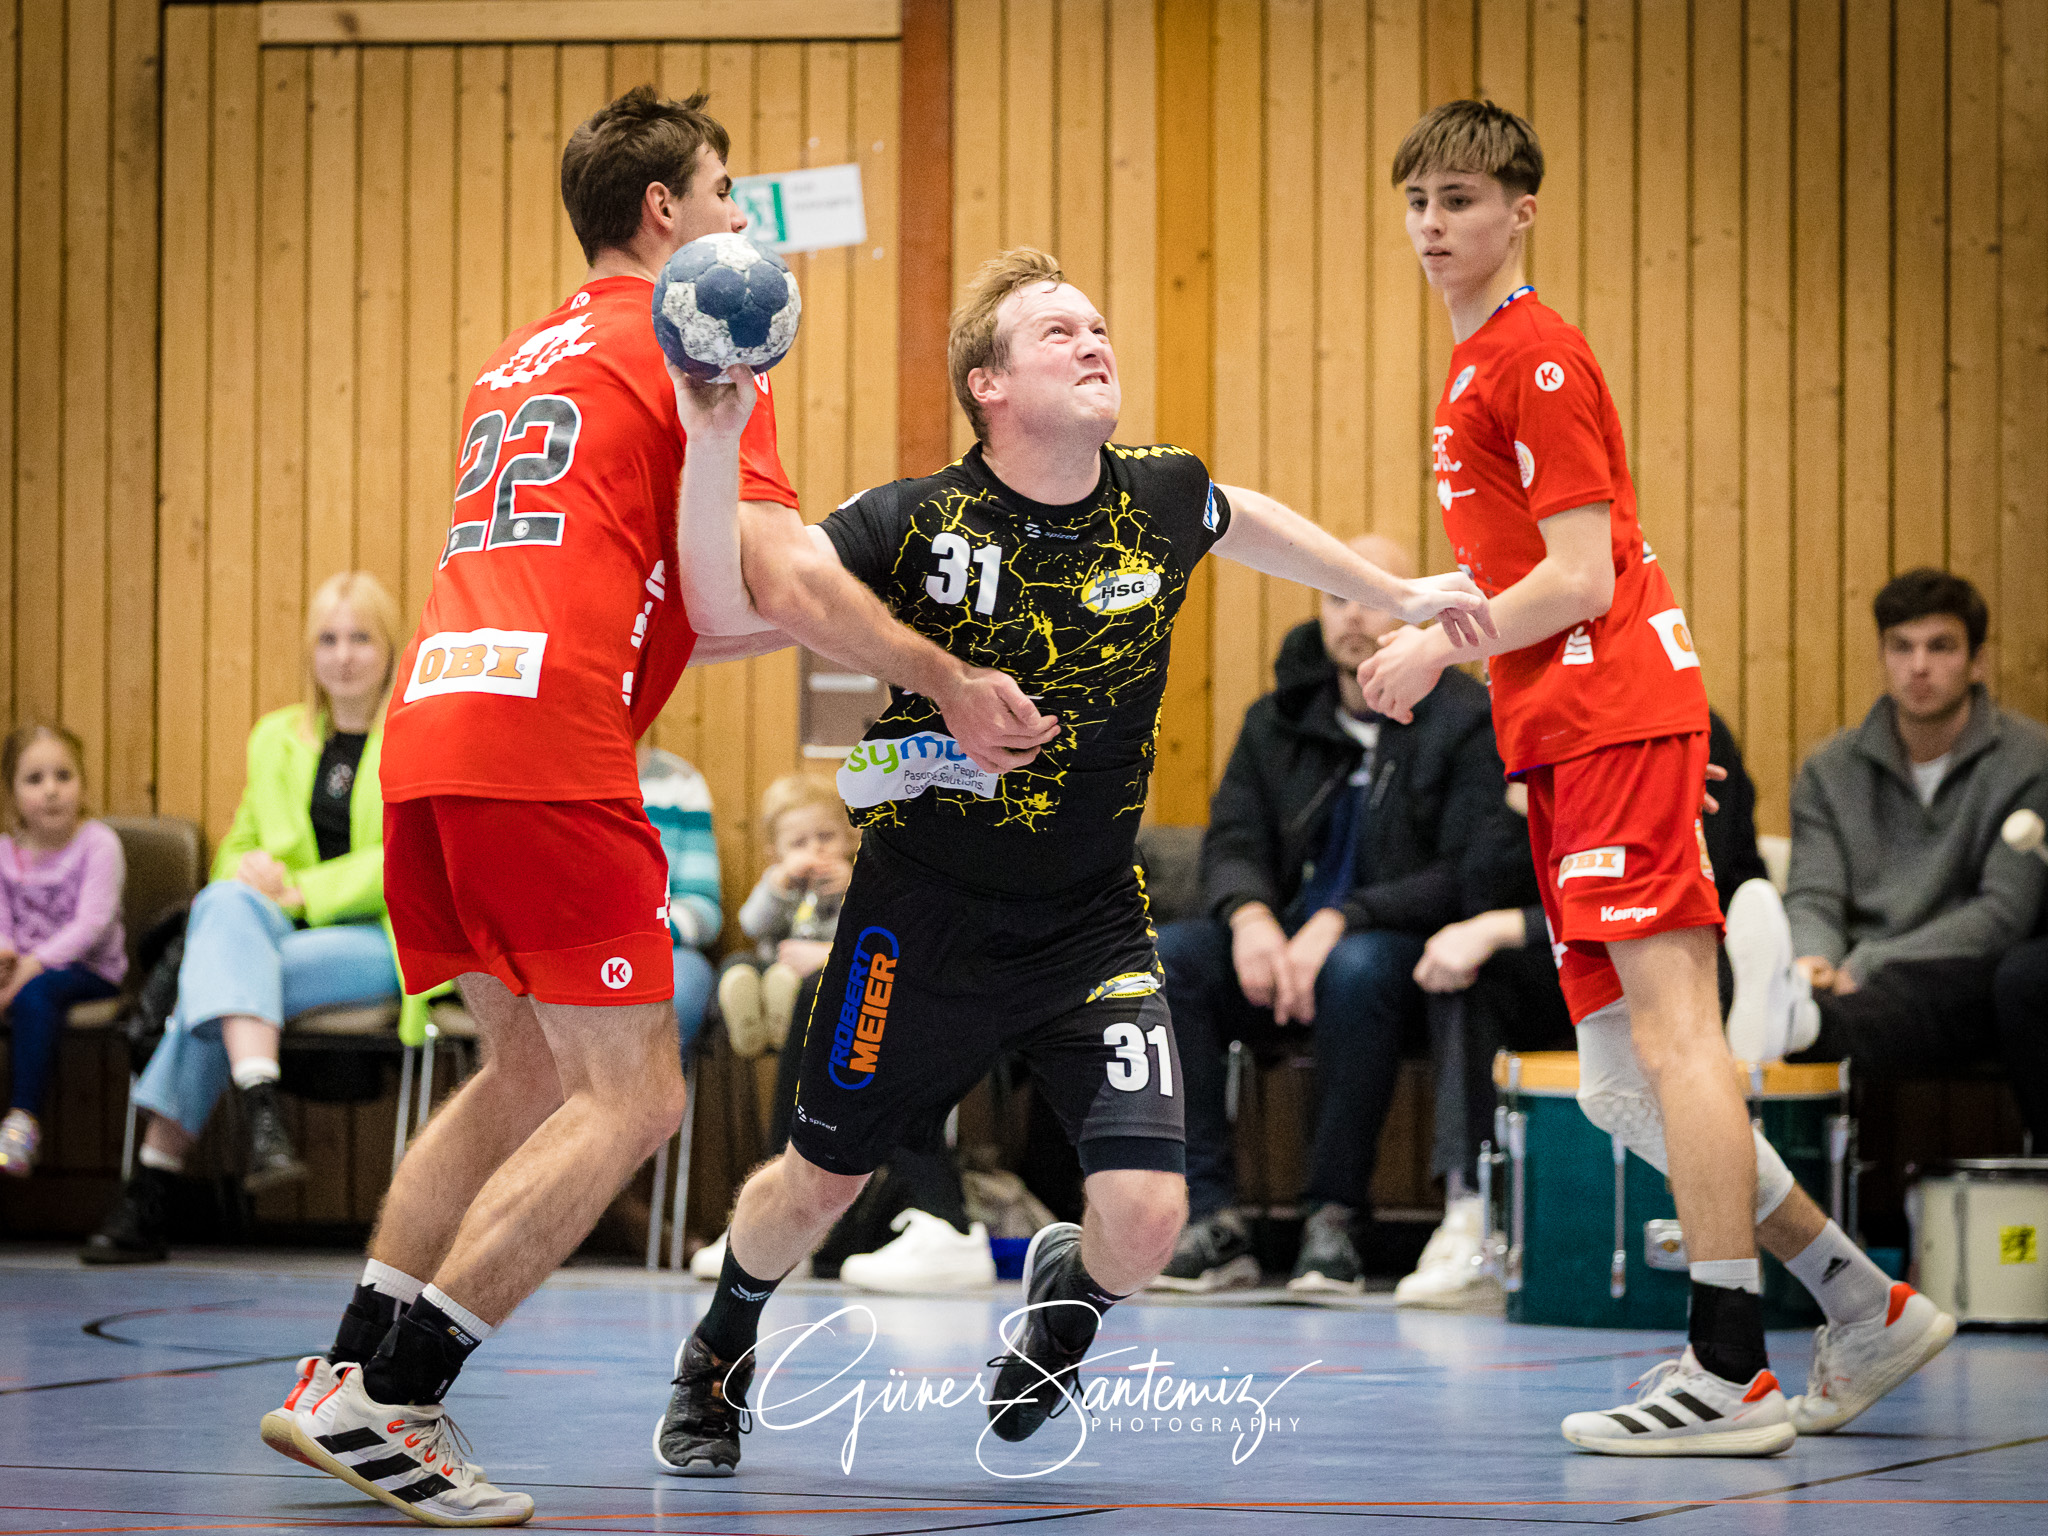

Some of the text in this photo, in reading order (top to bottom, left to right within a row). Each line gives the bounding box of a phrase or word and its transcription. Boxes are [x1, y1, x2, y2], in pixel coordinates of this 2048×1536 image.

[438, 394, 582, 571] 22
[925, 532, 1003, 616] 31
[1101, 581, 1145, 599] HSG
[418, 644, 529, 685] OBI
[1600, 906, 1658, 923] Kempa
[829, 940, 871, 1069] ROBERT
[849, 953, 898, 1073] MEIER
[1103, 1022, 1174, 1097] 31
